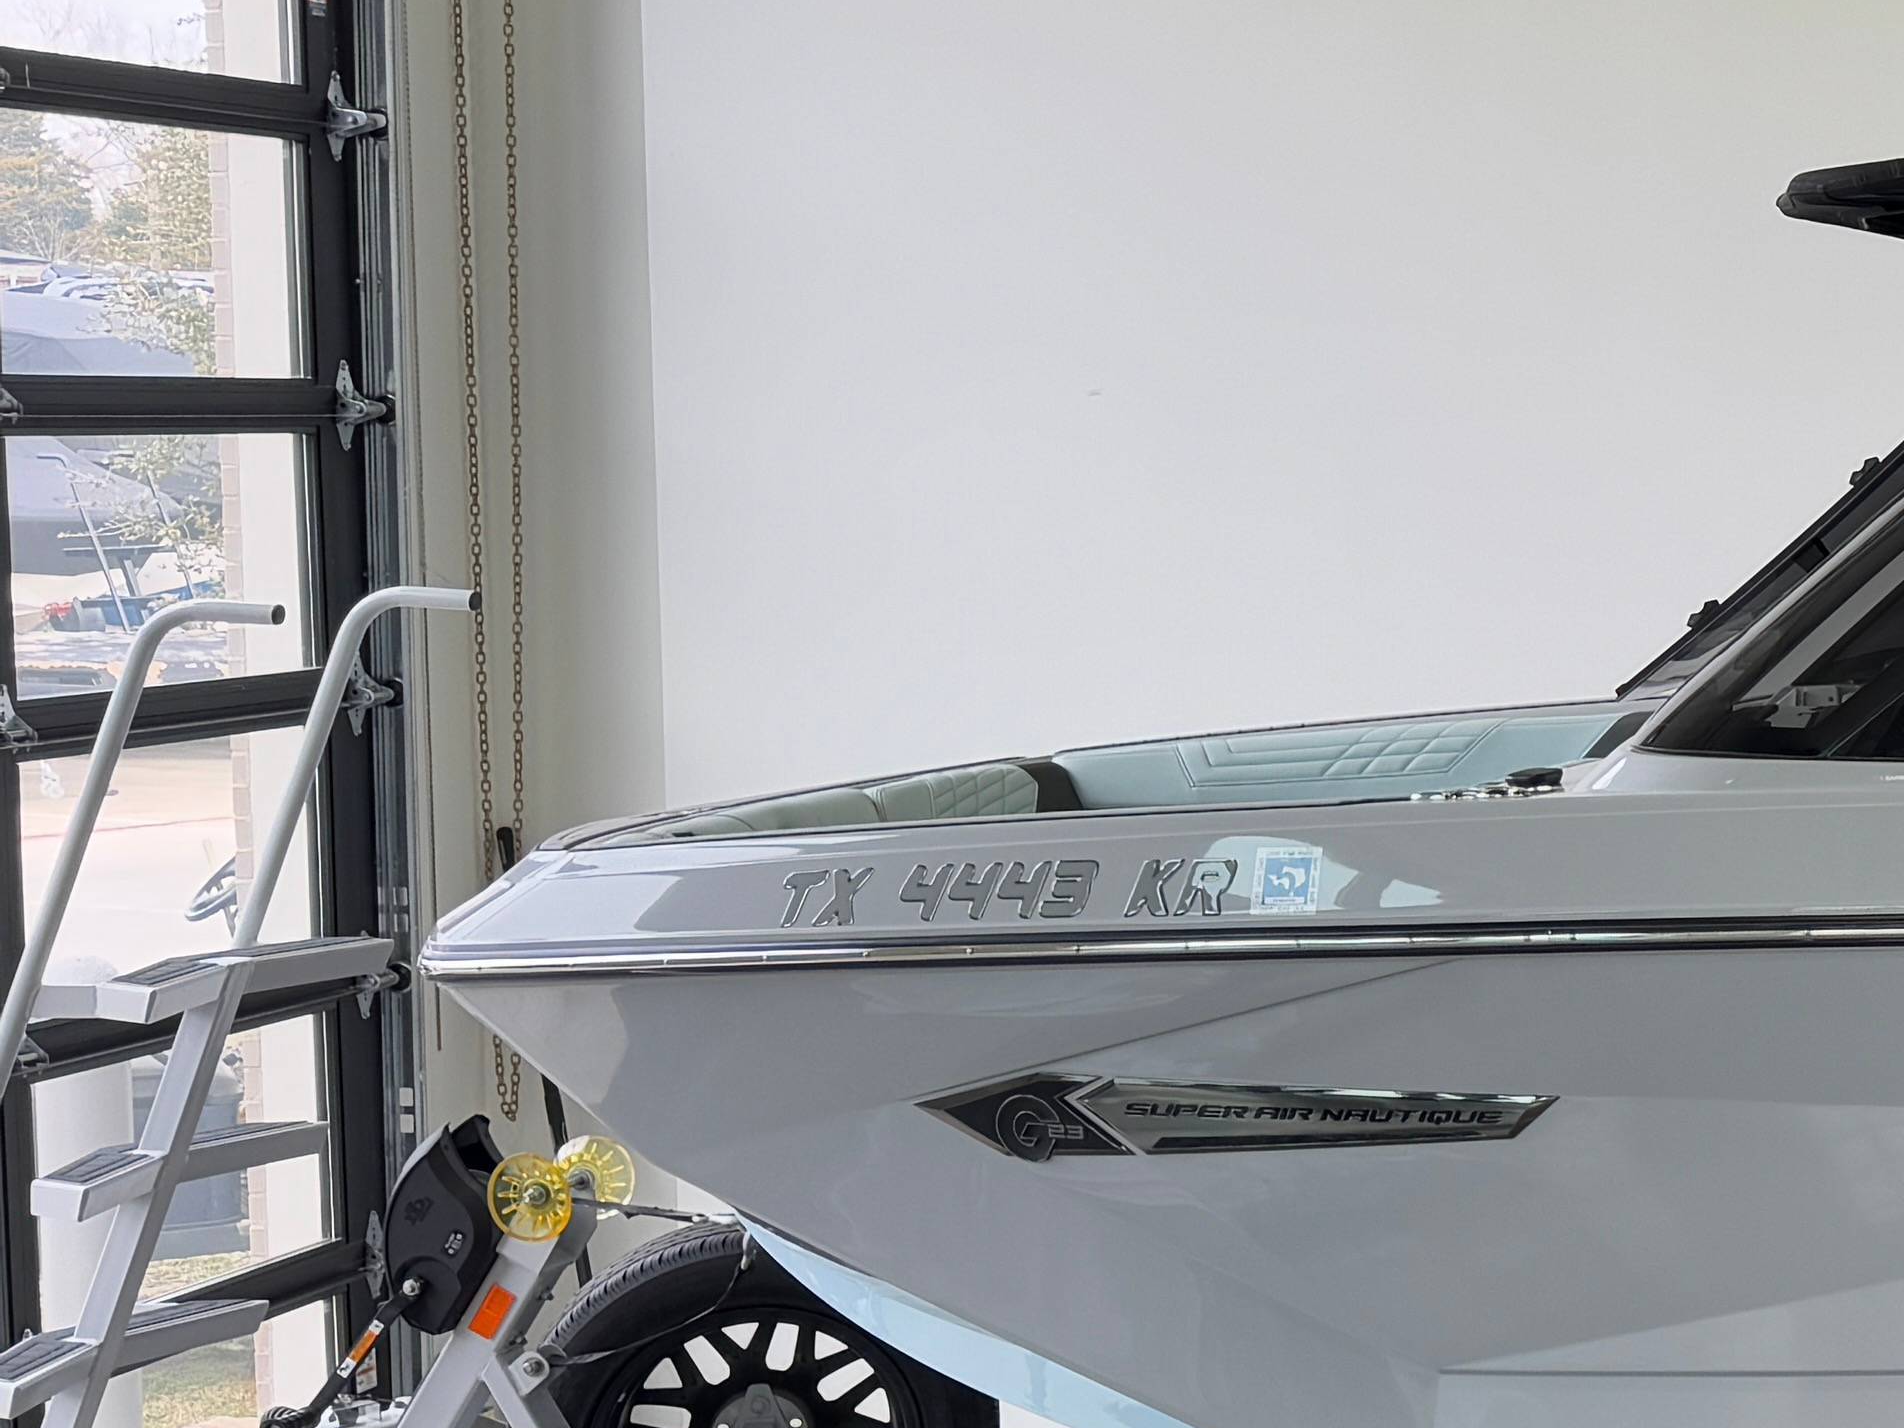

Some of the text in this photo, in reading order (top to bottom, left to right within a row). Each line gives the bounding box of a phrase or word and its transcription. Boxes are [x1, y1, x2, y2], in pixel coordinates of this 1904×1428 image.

[780, 867, 874, 928] TX
[899, 859, 1099, 922] 4443
[1123, 858, 1238, 917] KR
[1124, 1102, 1504, 1125] SUPER AIR NAUTIQUE
